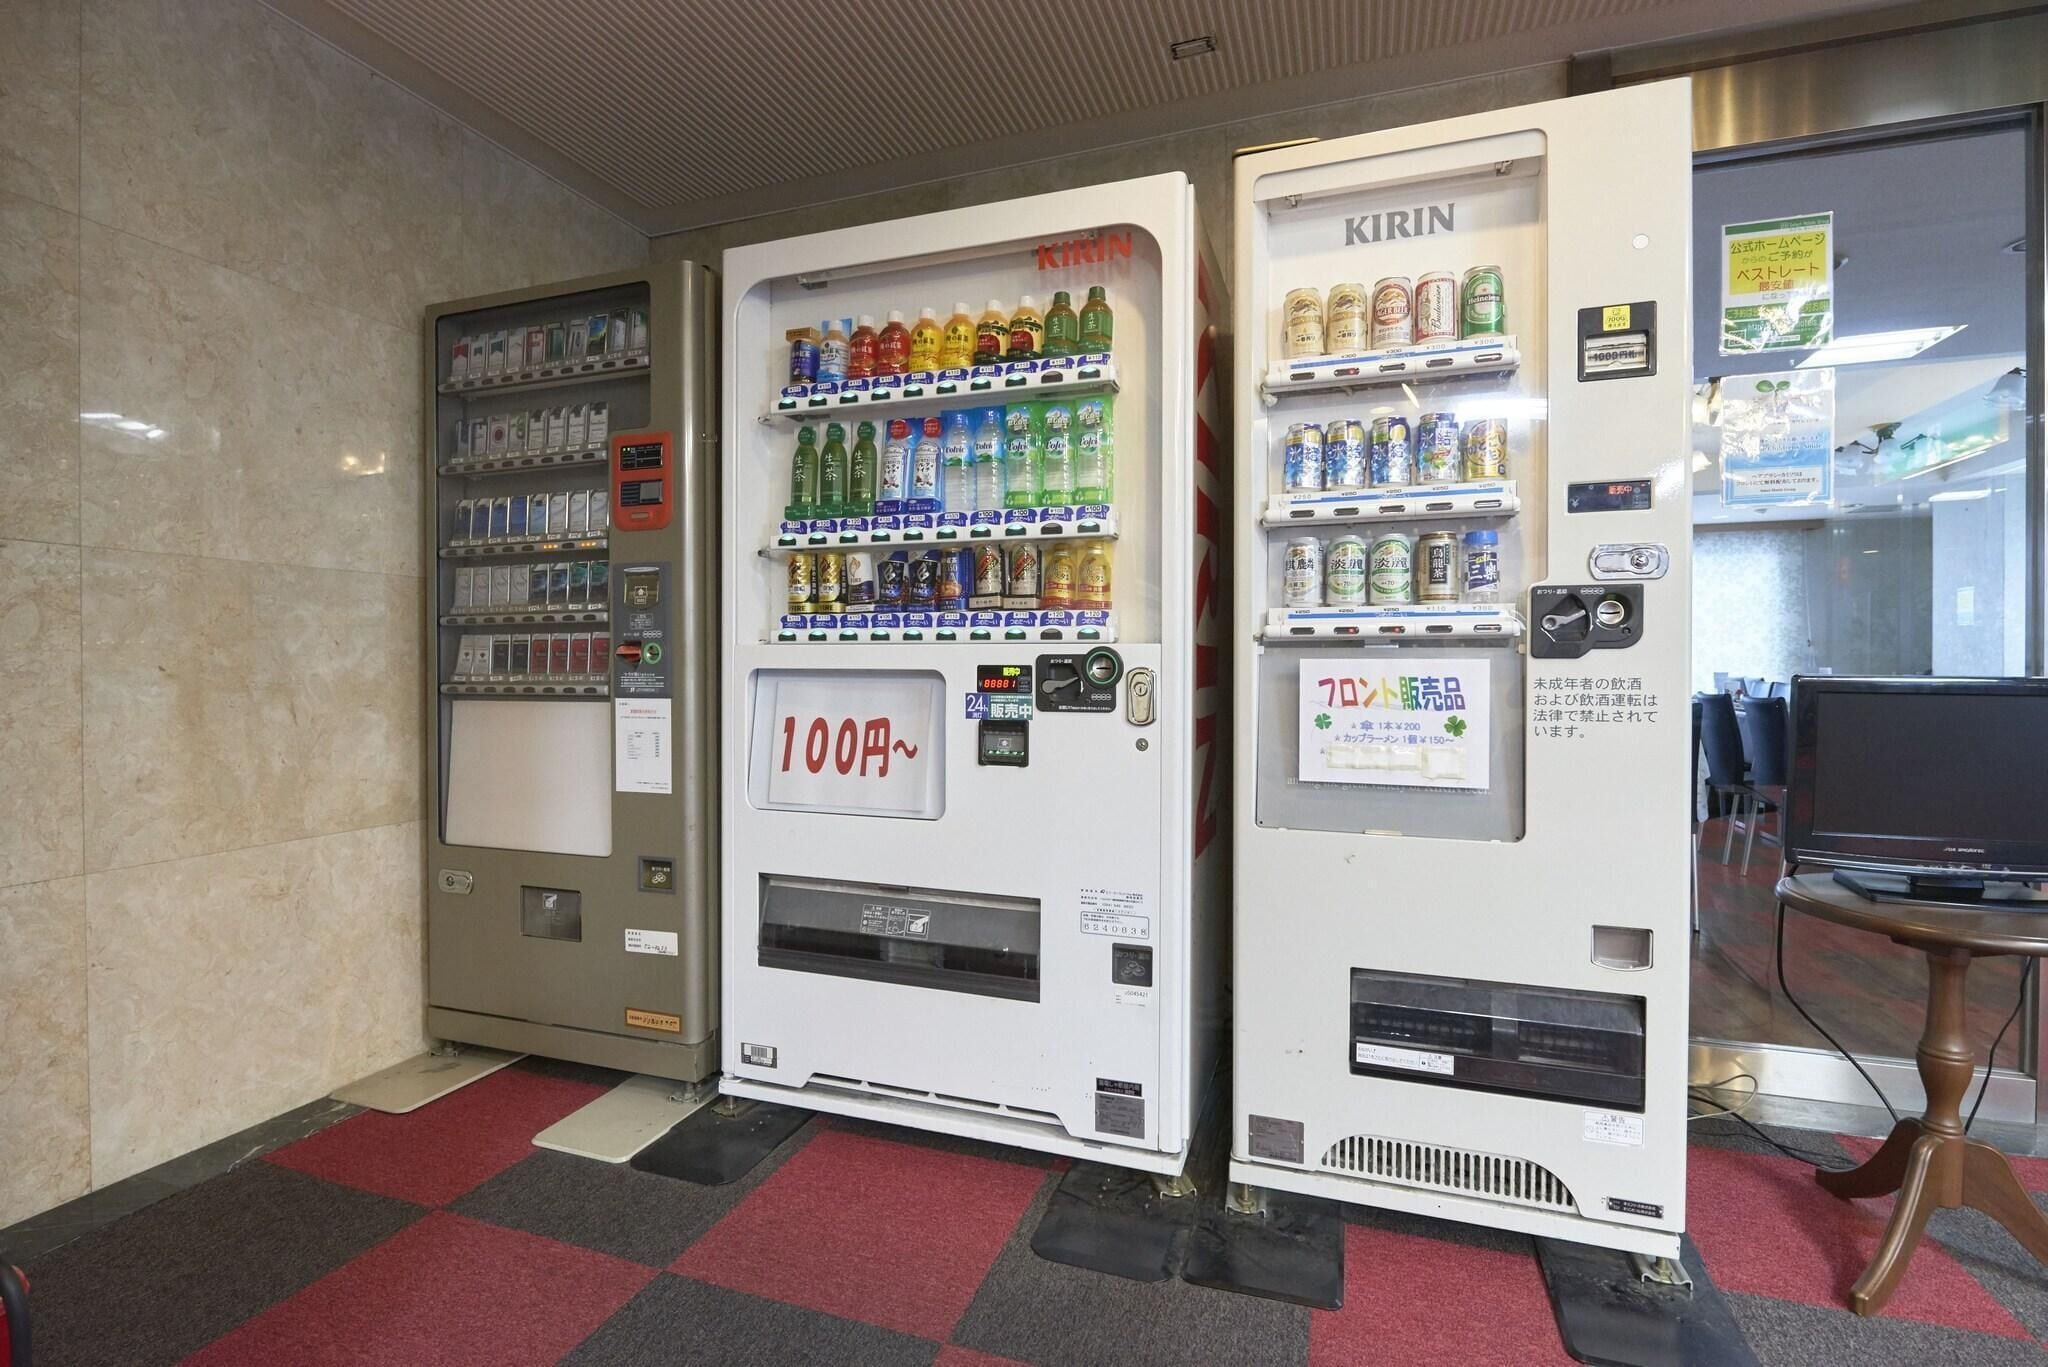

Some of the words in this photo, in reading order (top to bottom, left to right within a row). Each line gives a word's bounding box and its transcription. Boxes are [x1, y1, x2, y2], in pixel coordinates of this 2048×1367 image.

[1345, 203, 1455, 246] KIRIN
[1731, 232, 1825, 254] 公式ホームページ
[1036, 232, 1132, 271] KIRIN
[1737, 262, 1819, 281] ベストレート
[1430, 284, 1442, 332] Budweiser
[1008, 441, 1027, 451] Volvi
[1046, 440, 1067, 450] Volvi
[1079, 435, 1099, 446] Volvi
[1421, 430, 1452, 446] 氷結
[1289, 446, 1319, 462] 氷結
[1374, 443, 1404, 459] 氷結
[794, 455, 806, 482] 生茶
[825, 452, 838, 481] 生茶
[854, 449, 866, 478] 生茶
[1331, 558, 1363, 570] 淡麗
[1373, 556, 1409, 569] 淡麗
[1533, 676, 1643, 690] 未成年者の飲酒
[1318, 675, 1466, 711] フロント販売品
[1533, 693, 1658, 707] および飲酒運転は
[966, 694, 989, 713] 24h
[990, 703, 1033, 719] 販売中
[1533, 709, 1658, 723] 法律で禁止されて
[1359, 720, 1374, 731] 傘
[1378, 721, 1421, 731] 1本¥200
[1534, 724, 1585, 738] います。
[1343, 733, 1399, 743] カップラーメン
